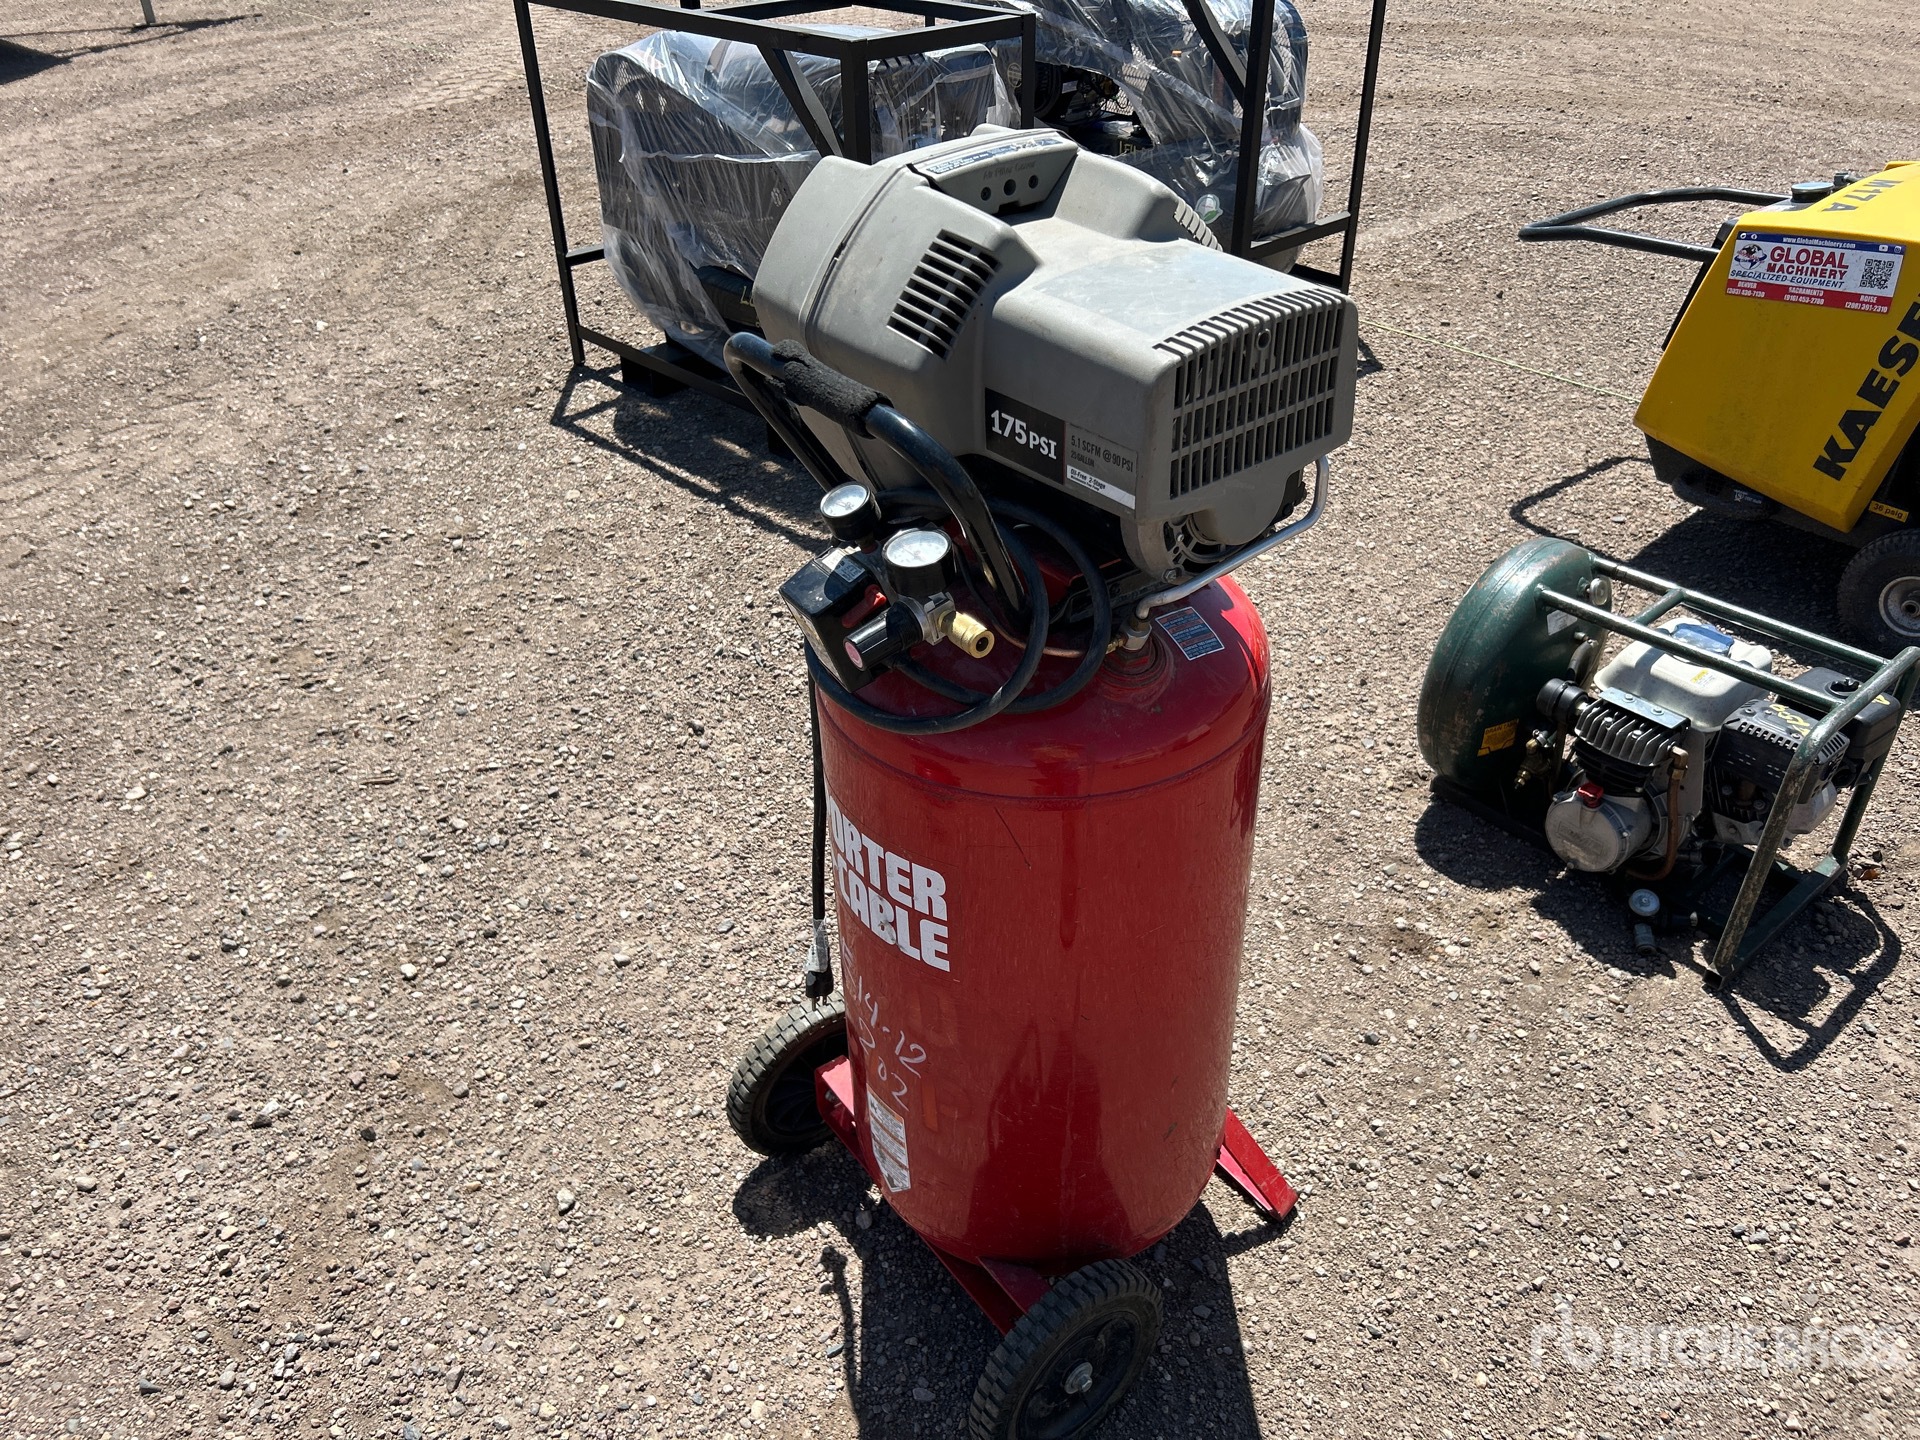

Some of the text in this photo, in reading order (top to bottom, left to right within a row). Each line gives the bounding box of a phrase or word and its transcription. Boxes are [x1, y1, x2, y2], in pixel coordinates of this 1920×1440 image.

[1770, 245, 1849, 270] GLOBAL
[1730, 269, 1846, 290] SPECIALIZED EQUIPMENT
[1766, 263, 1848, 281] MACHINERY
[1788, 286, 1824, 297] SACRAMENTO
[1859, 294, 1877, 304] BOISE
[1813, 293, 1920, 482] KAESE
[990, 409, 1057, 460] 175 PSI
[1071, 435, 1081, 449] 5.1
[1082, 440, 1101, 458] SCFM
[1121, 457, 1134, 473] PSI
[1070, 468, 1106, 490] Oil-Free 2-Stage
[1873, 502, 1884, 512] 36
[825, 783, 948, 922] ORTER
